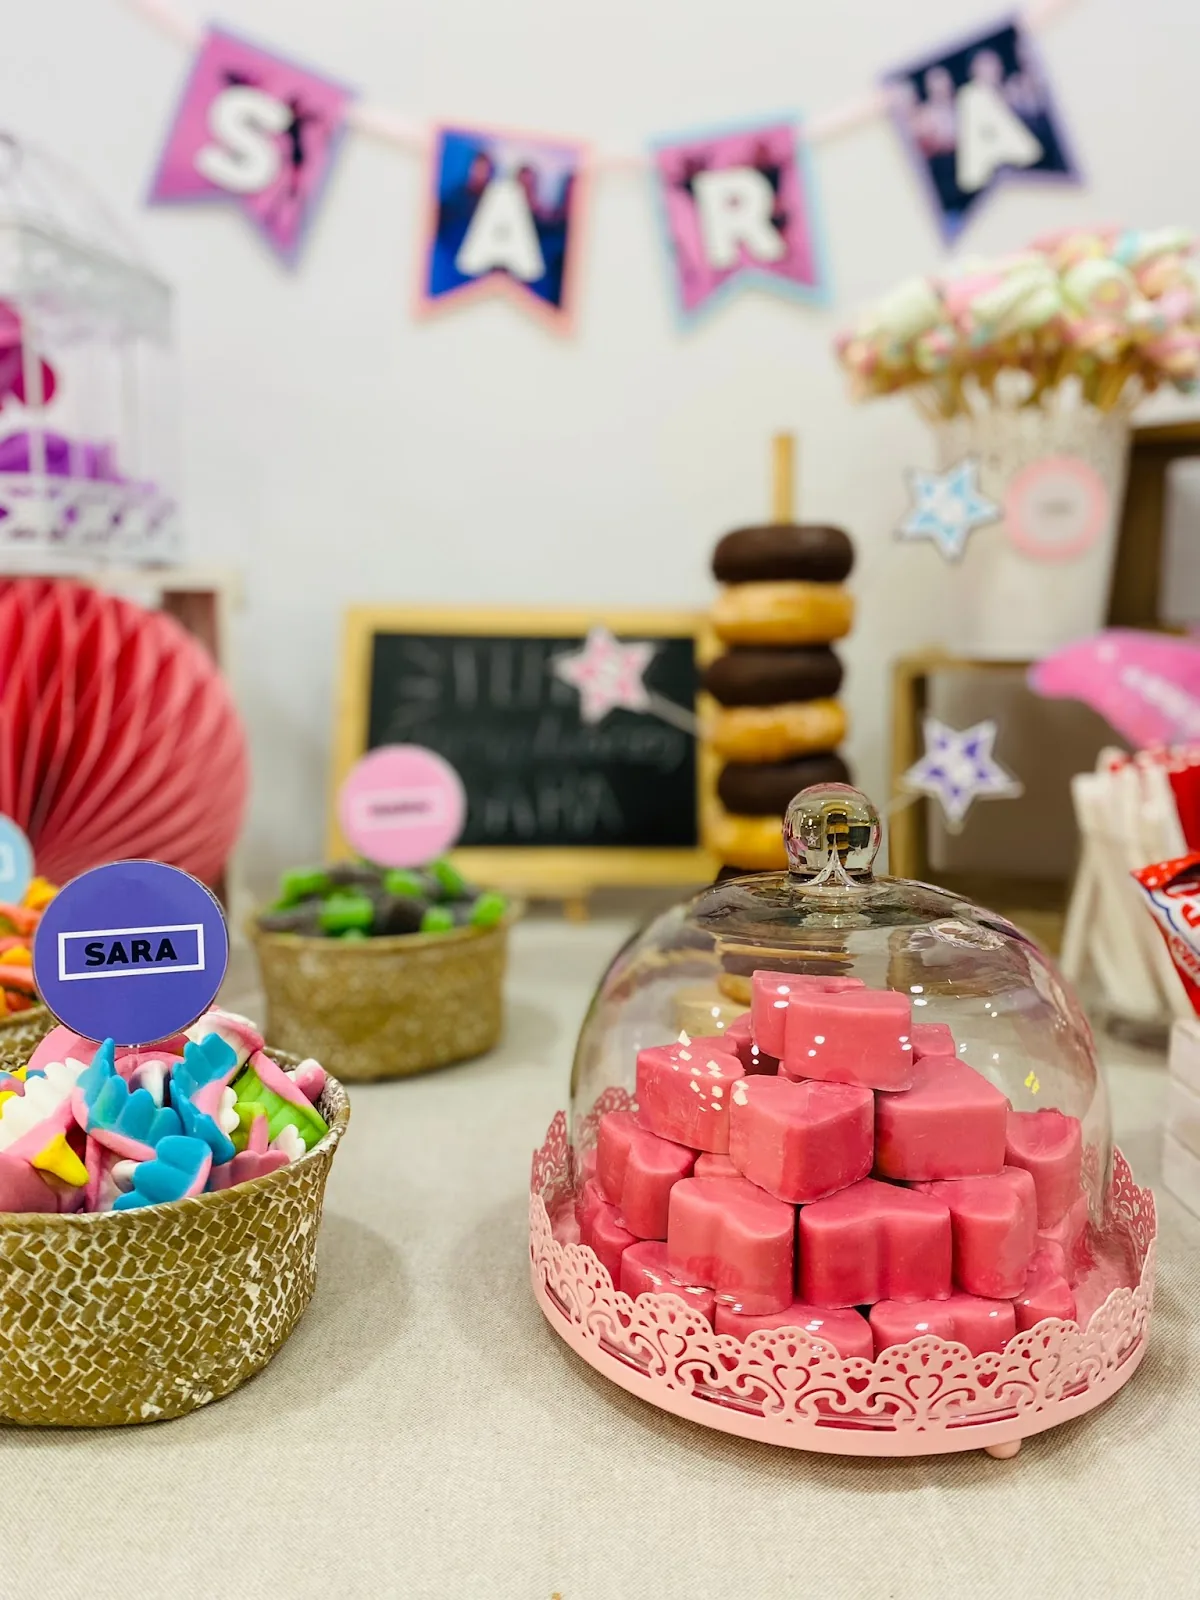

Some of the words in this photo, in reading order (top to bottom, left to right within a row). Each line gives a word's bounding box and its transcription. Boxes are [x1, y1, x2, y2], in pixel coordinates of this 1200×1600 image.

[194, 86, 292, 192] S
[455, 177, 545, 282] A
[691, 168, 786, 267] R
[955, 78, 1043, 192] A
[84, 937, 178, 966] SARA
